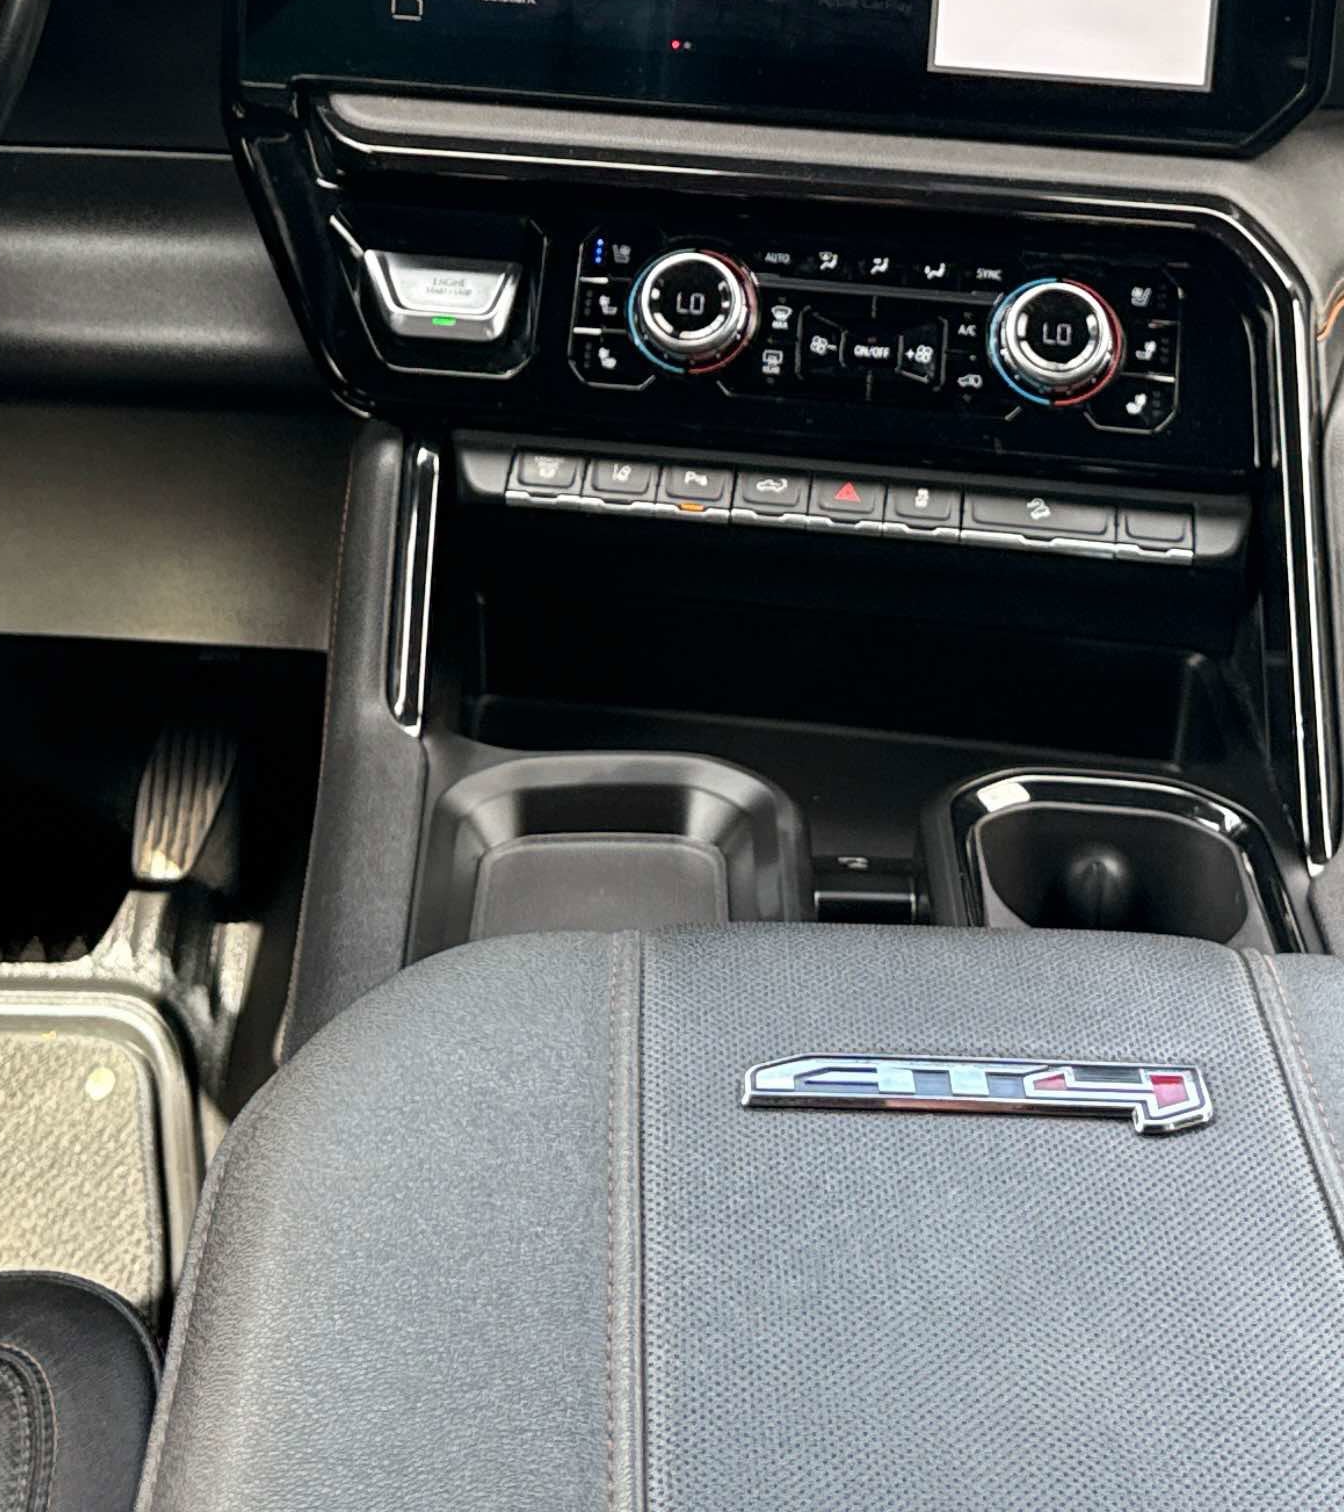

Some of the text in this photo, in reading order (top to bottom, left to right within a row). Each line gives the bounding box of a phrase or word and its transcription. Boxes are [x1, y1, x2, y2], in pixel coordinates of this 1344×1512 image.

[765, 253, 791, 264] AUTO
[976, 268, 1003, 280] SYNC
[676, 291, 705, 315] LO
[958, 324, 977, 336] A/C
[1042, 322, 1072, 346] LO
[854, 344, 890, 358] ON/OFF
[742, 1054, 1213, 1135] AT4
